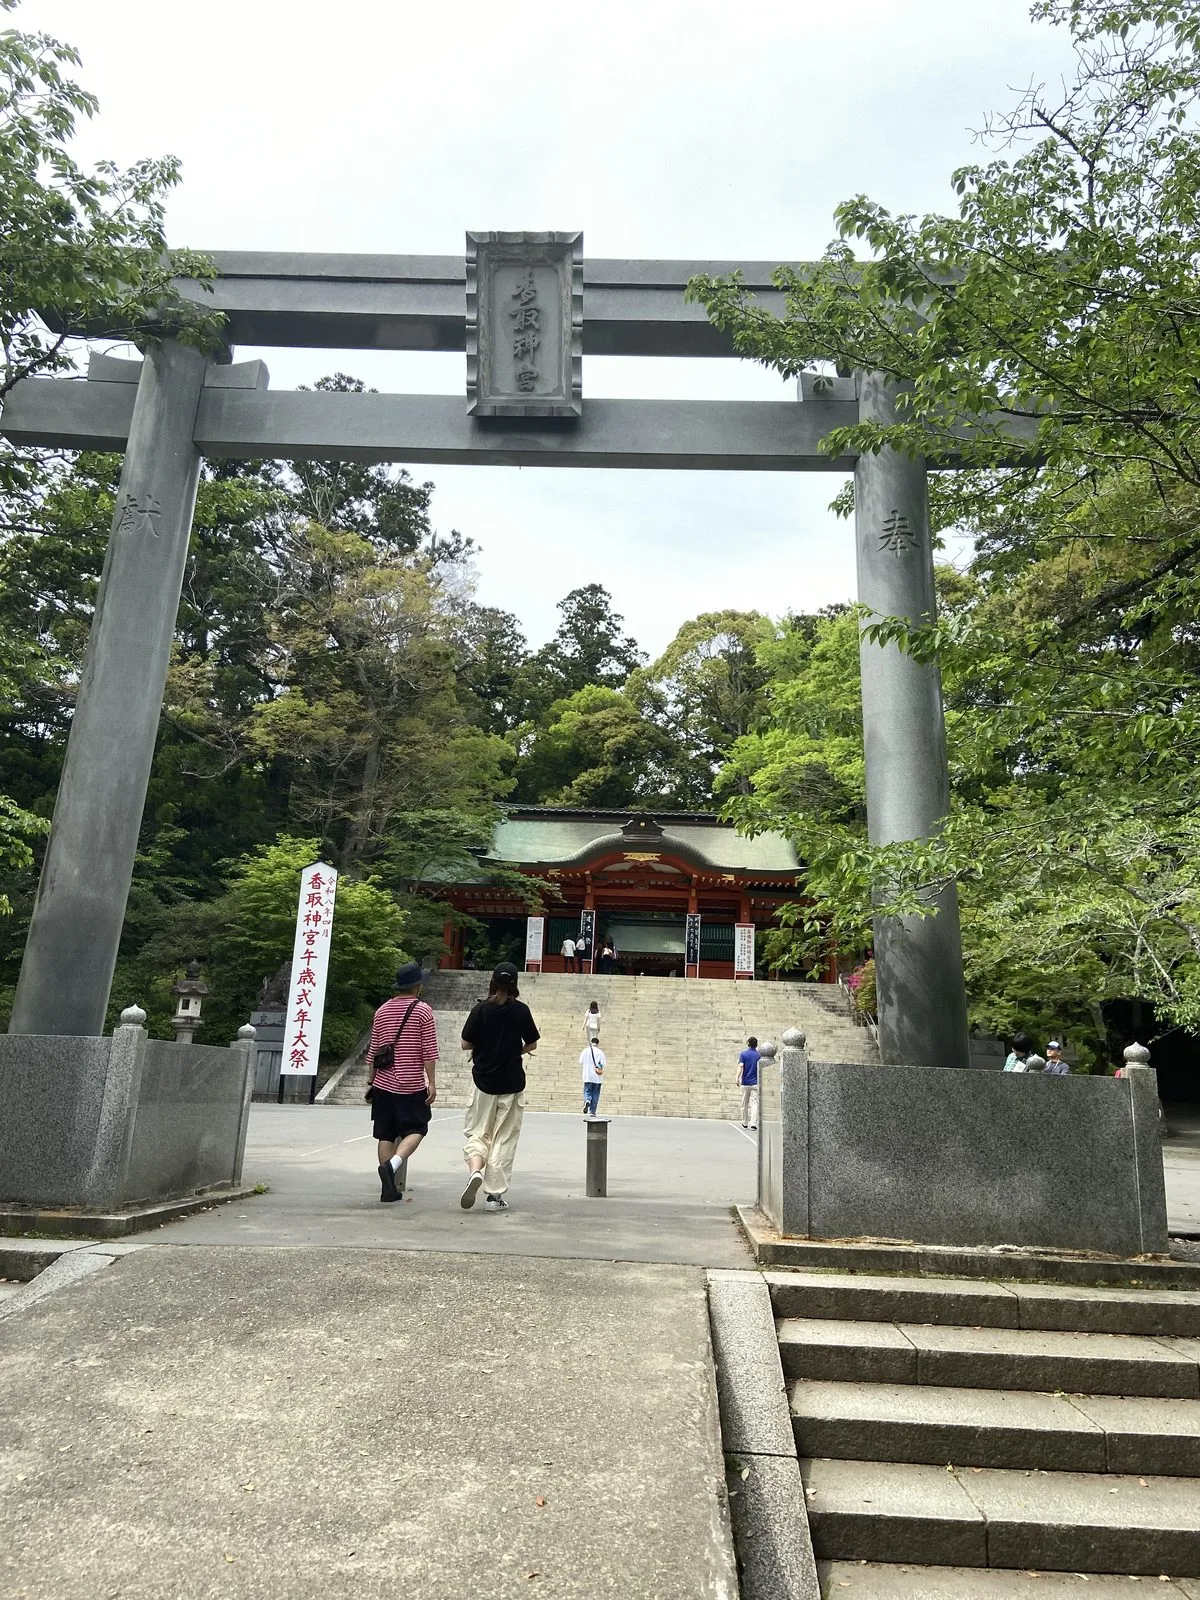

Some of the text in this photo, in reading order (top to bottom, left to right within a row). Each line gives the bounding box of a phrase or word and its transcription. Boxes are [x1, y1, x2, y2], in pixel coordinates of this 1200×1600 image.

[876, 509, 922, 559] 奉
[321, 875, 336, 939] 令和八年四月
[289, 872, 326, 1069] 香取神宮午歳式年大祭
